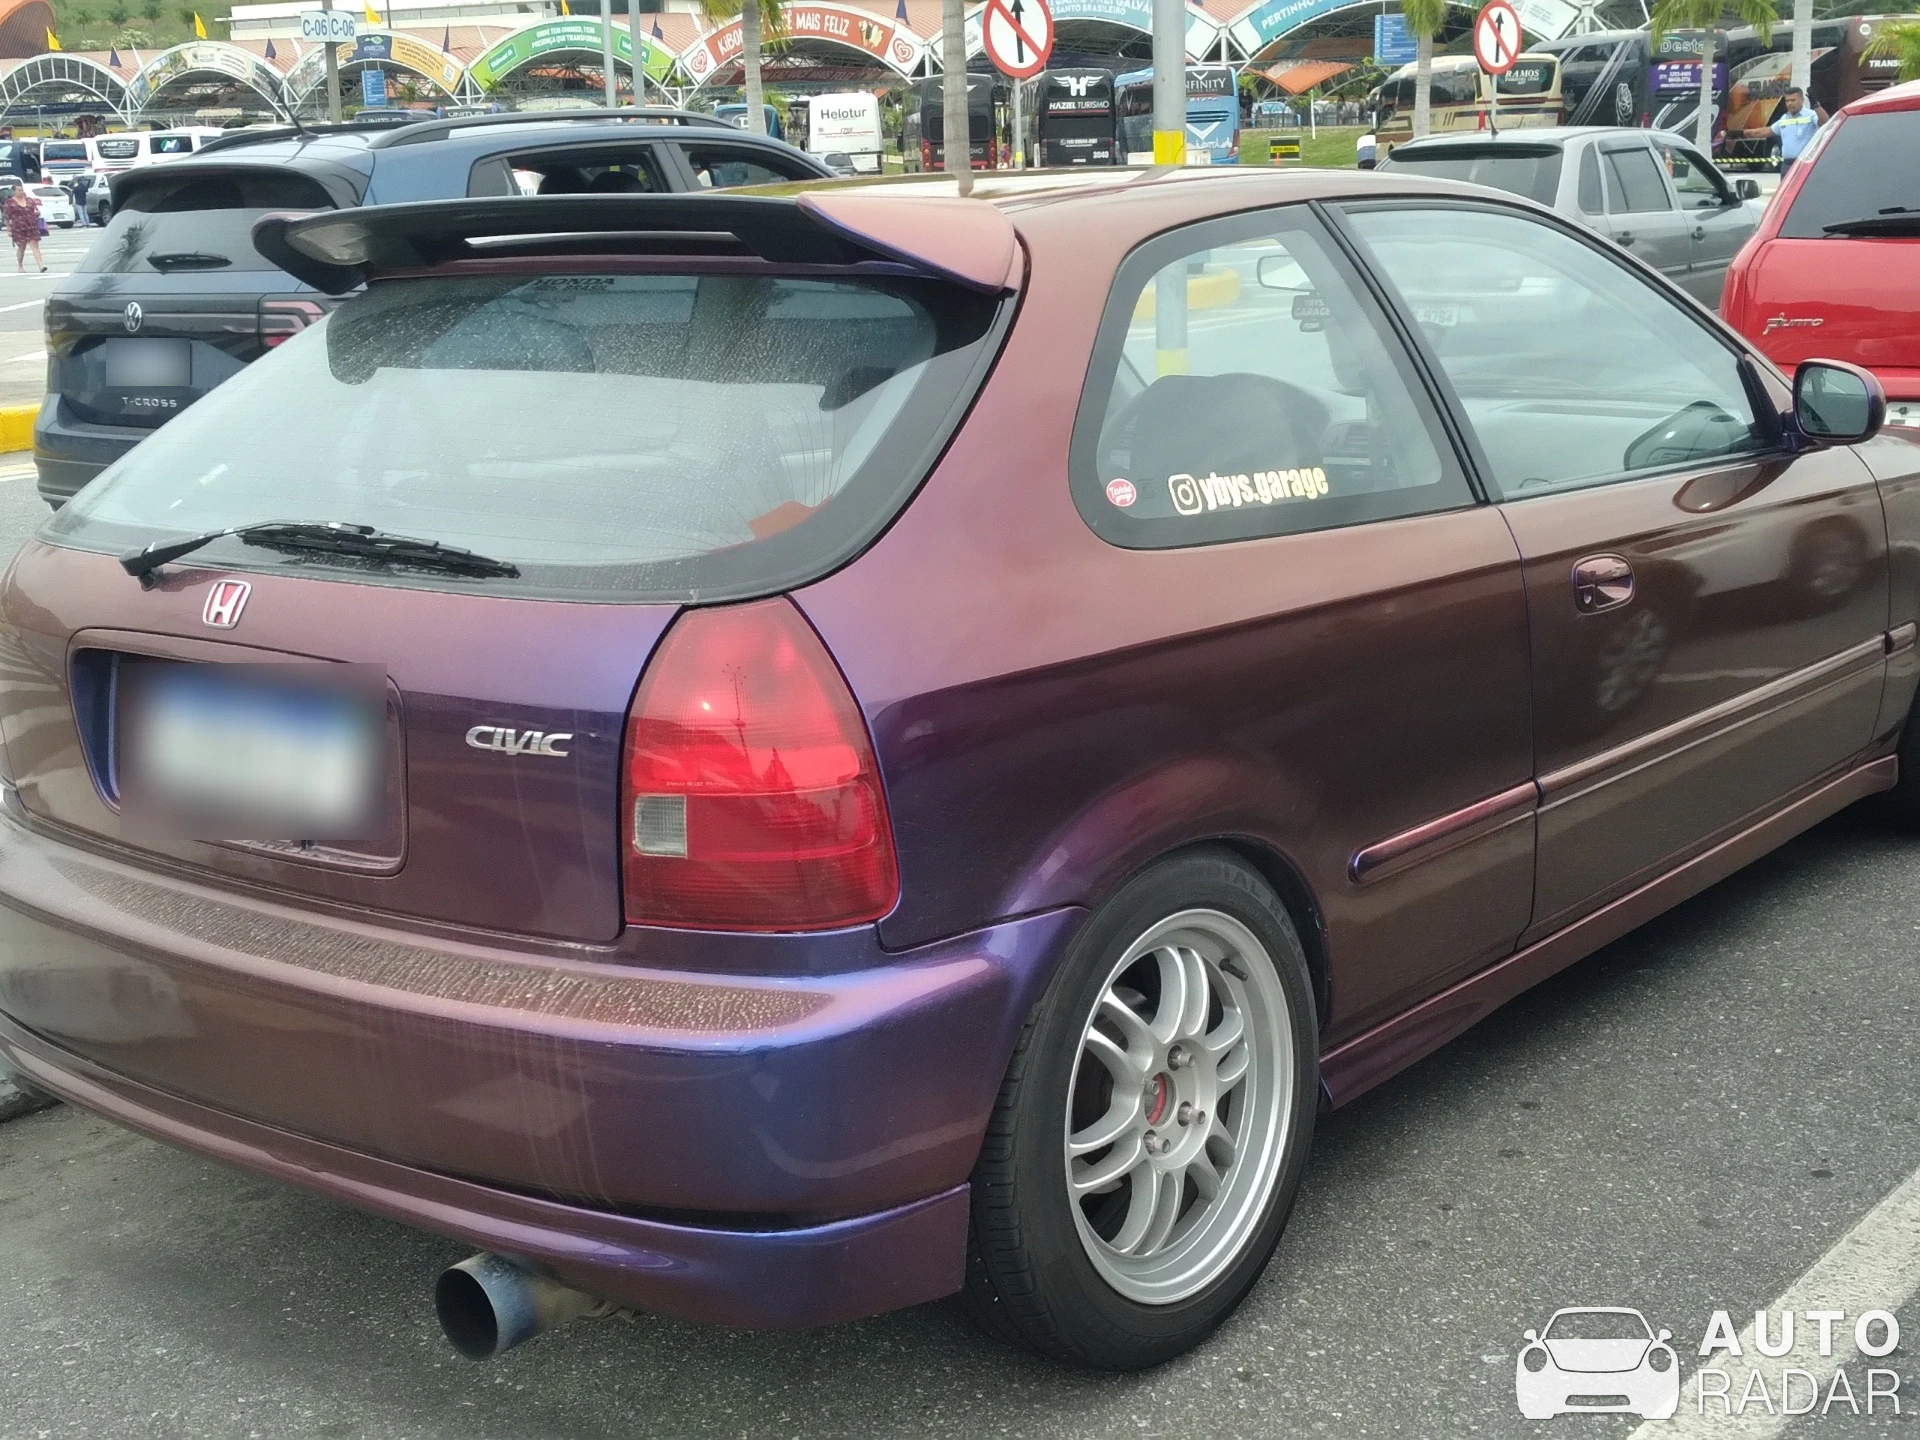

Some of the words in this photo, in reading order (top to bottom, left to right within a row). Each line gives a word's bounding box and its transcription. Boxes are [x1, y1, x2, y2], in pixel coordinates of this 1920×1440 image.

[1056, 5, 1080, 14] SANTO
[1082, 4, 1126, 15] BRASILEIRO
[303, 18, 328, 36] C-06
[331, 18, 355, 37] C-06
[796, 12, 821, 31] MAIS
[824, 14, 850, 37] FELIZ
[1504, 69, 1540, 78] RAMOS
[1185, 78, 1226, 90] NFINITY
[1049, 102, 1076, 110] HAZIEL
[1077, 100, 1110, 109] TURISMO
[820, 108, 867, 120] Helotur
[532, 278, 615, 286] HONDA
[122, 396, 177, 408] T-CROSS
[1198, 466, 1329, 511] ybys.garage
[465, 725, 574, 757] CIVIC
